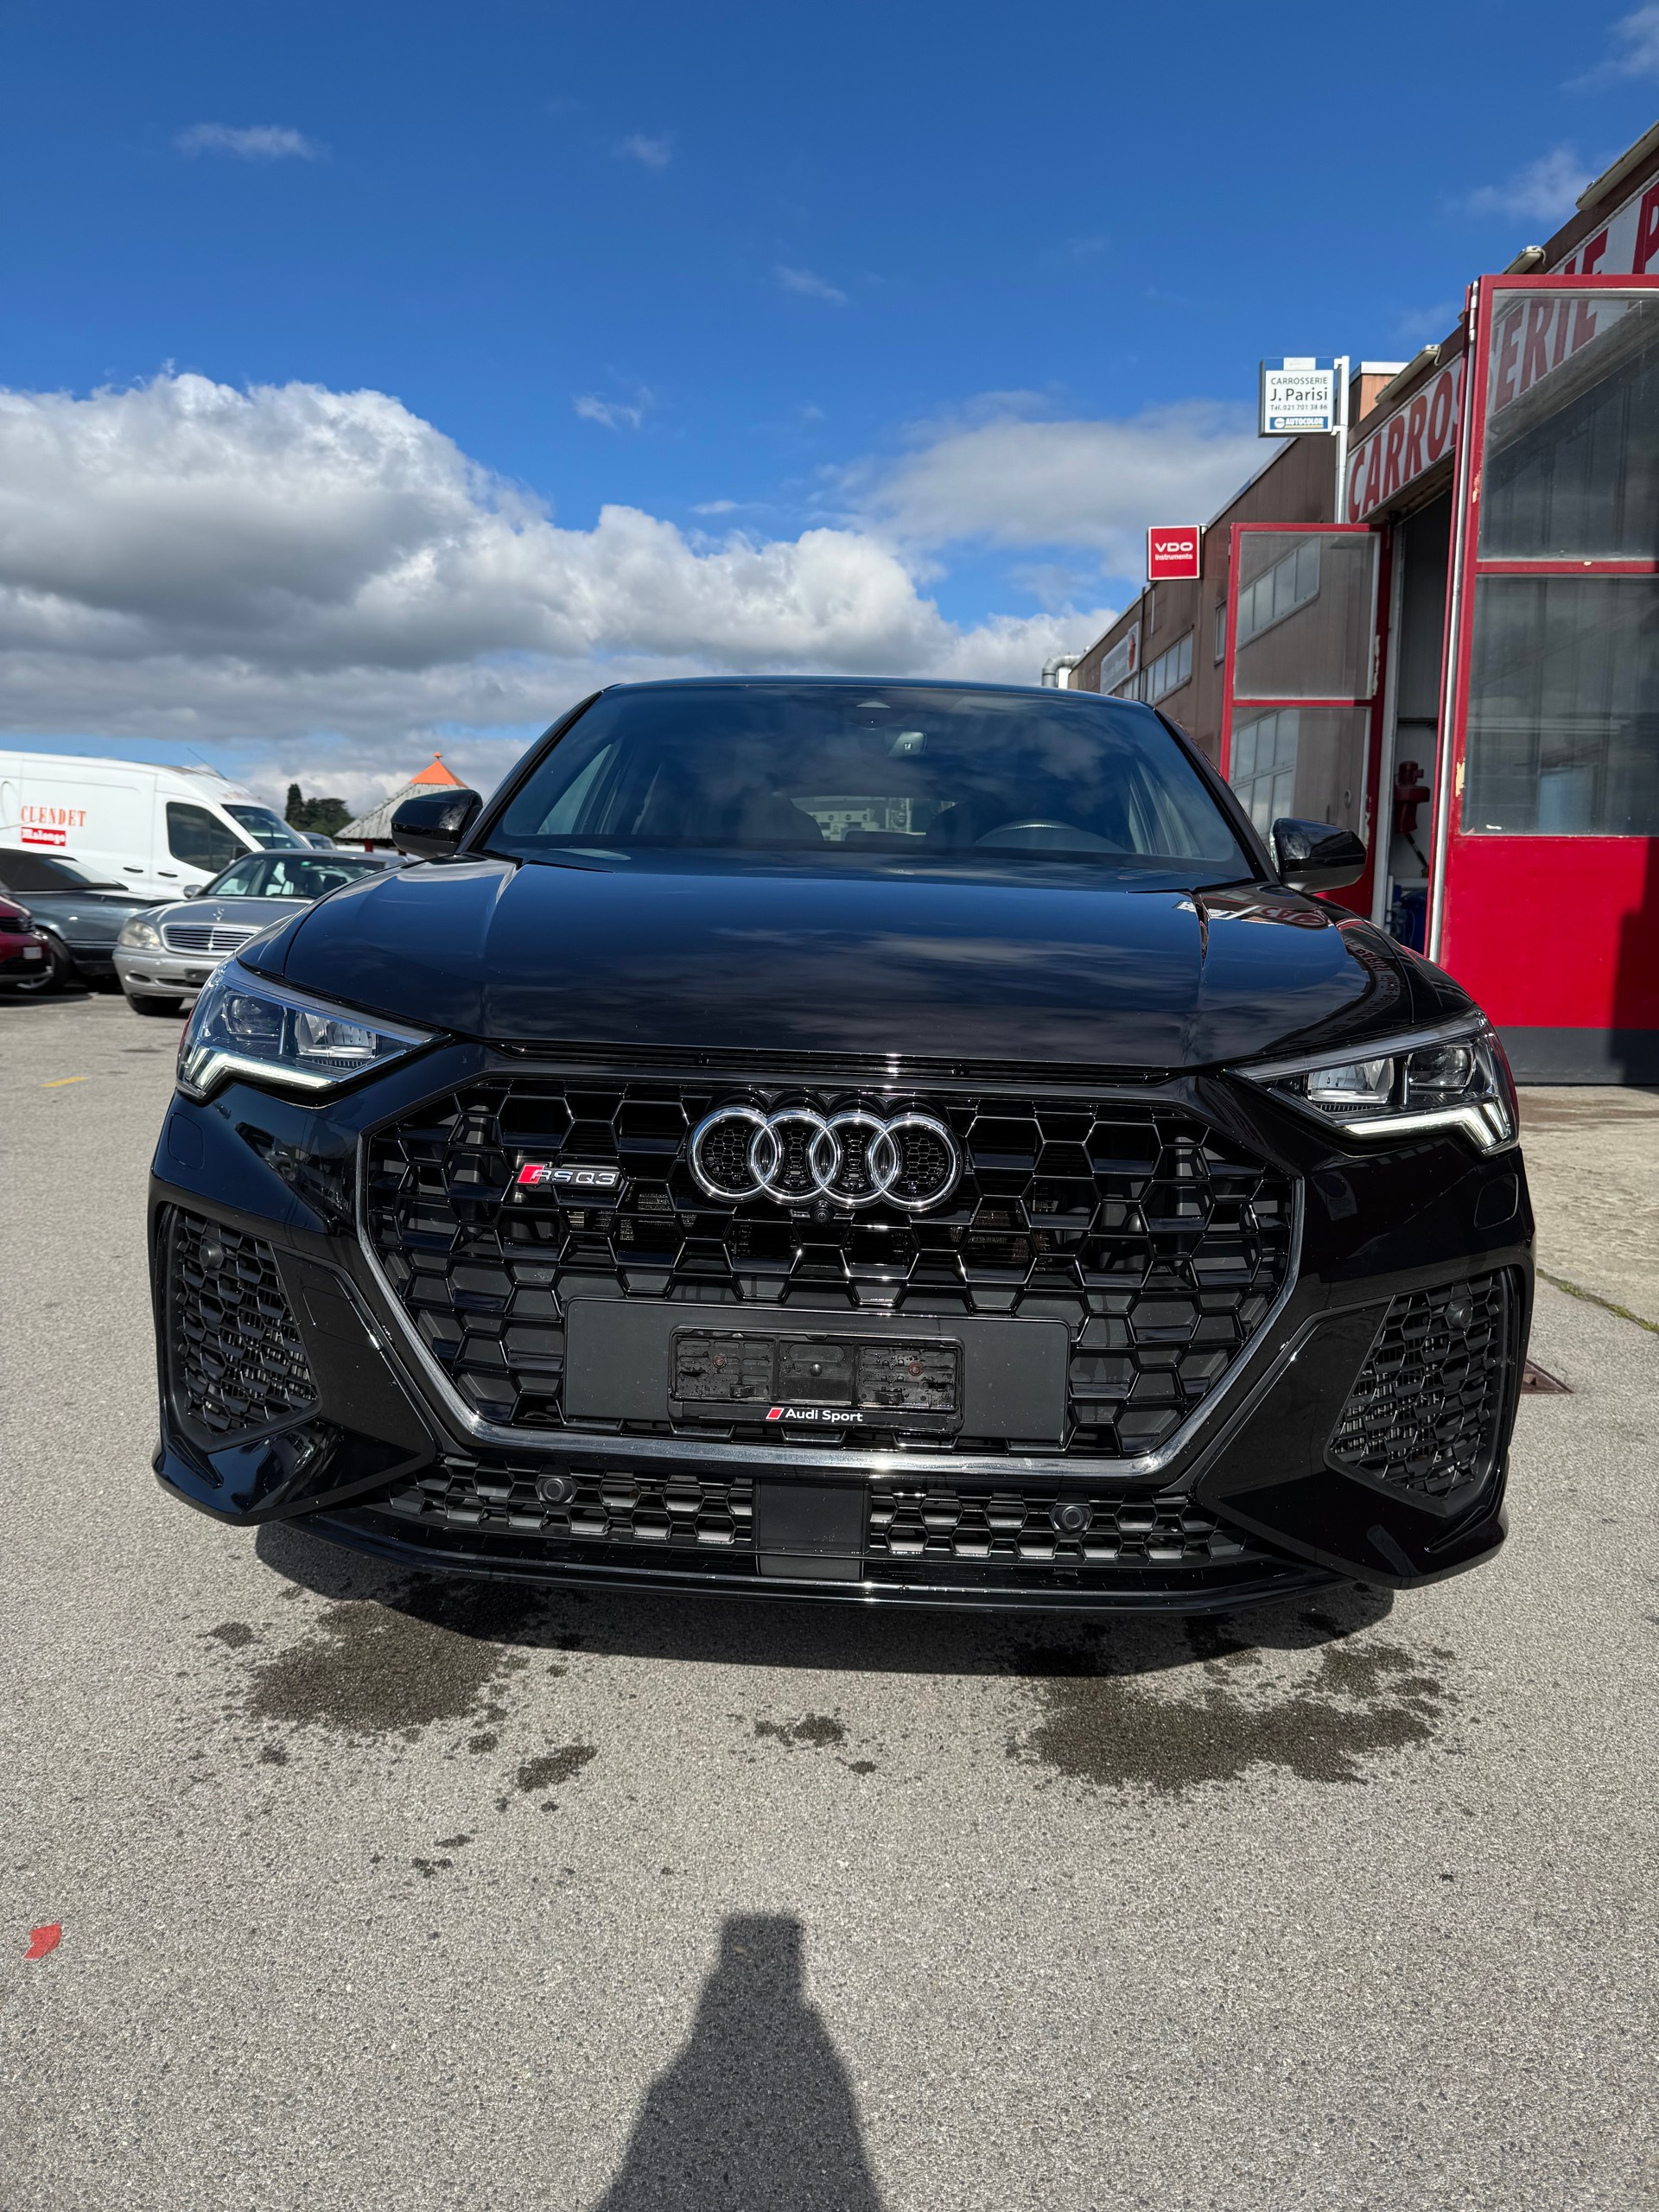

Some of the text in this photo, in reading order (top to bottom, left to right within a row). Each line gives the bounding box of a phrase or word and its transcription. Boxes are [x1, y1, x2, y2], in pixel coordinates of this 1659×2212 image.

[1270, 377, 1328, 385] CARROSSERIE
[1270, 387, 1328, 402] J. Parisi
[1154, 542, 1193, 553] VDO
[21, 805, 87, 827] CLENDET
[785, 1408, 863, 1423] Audi Sport
